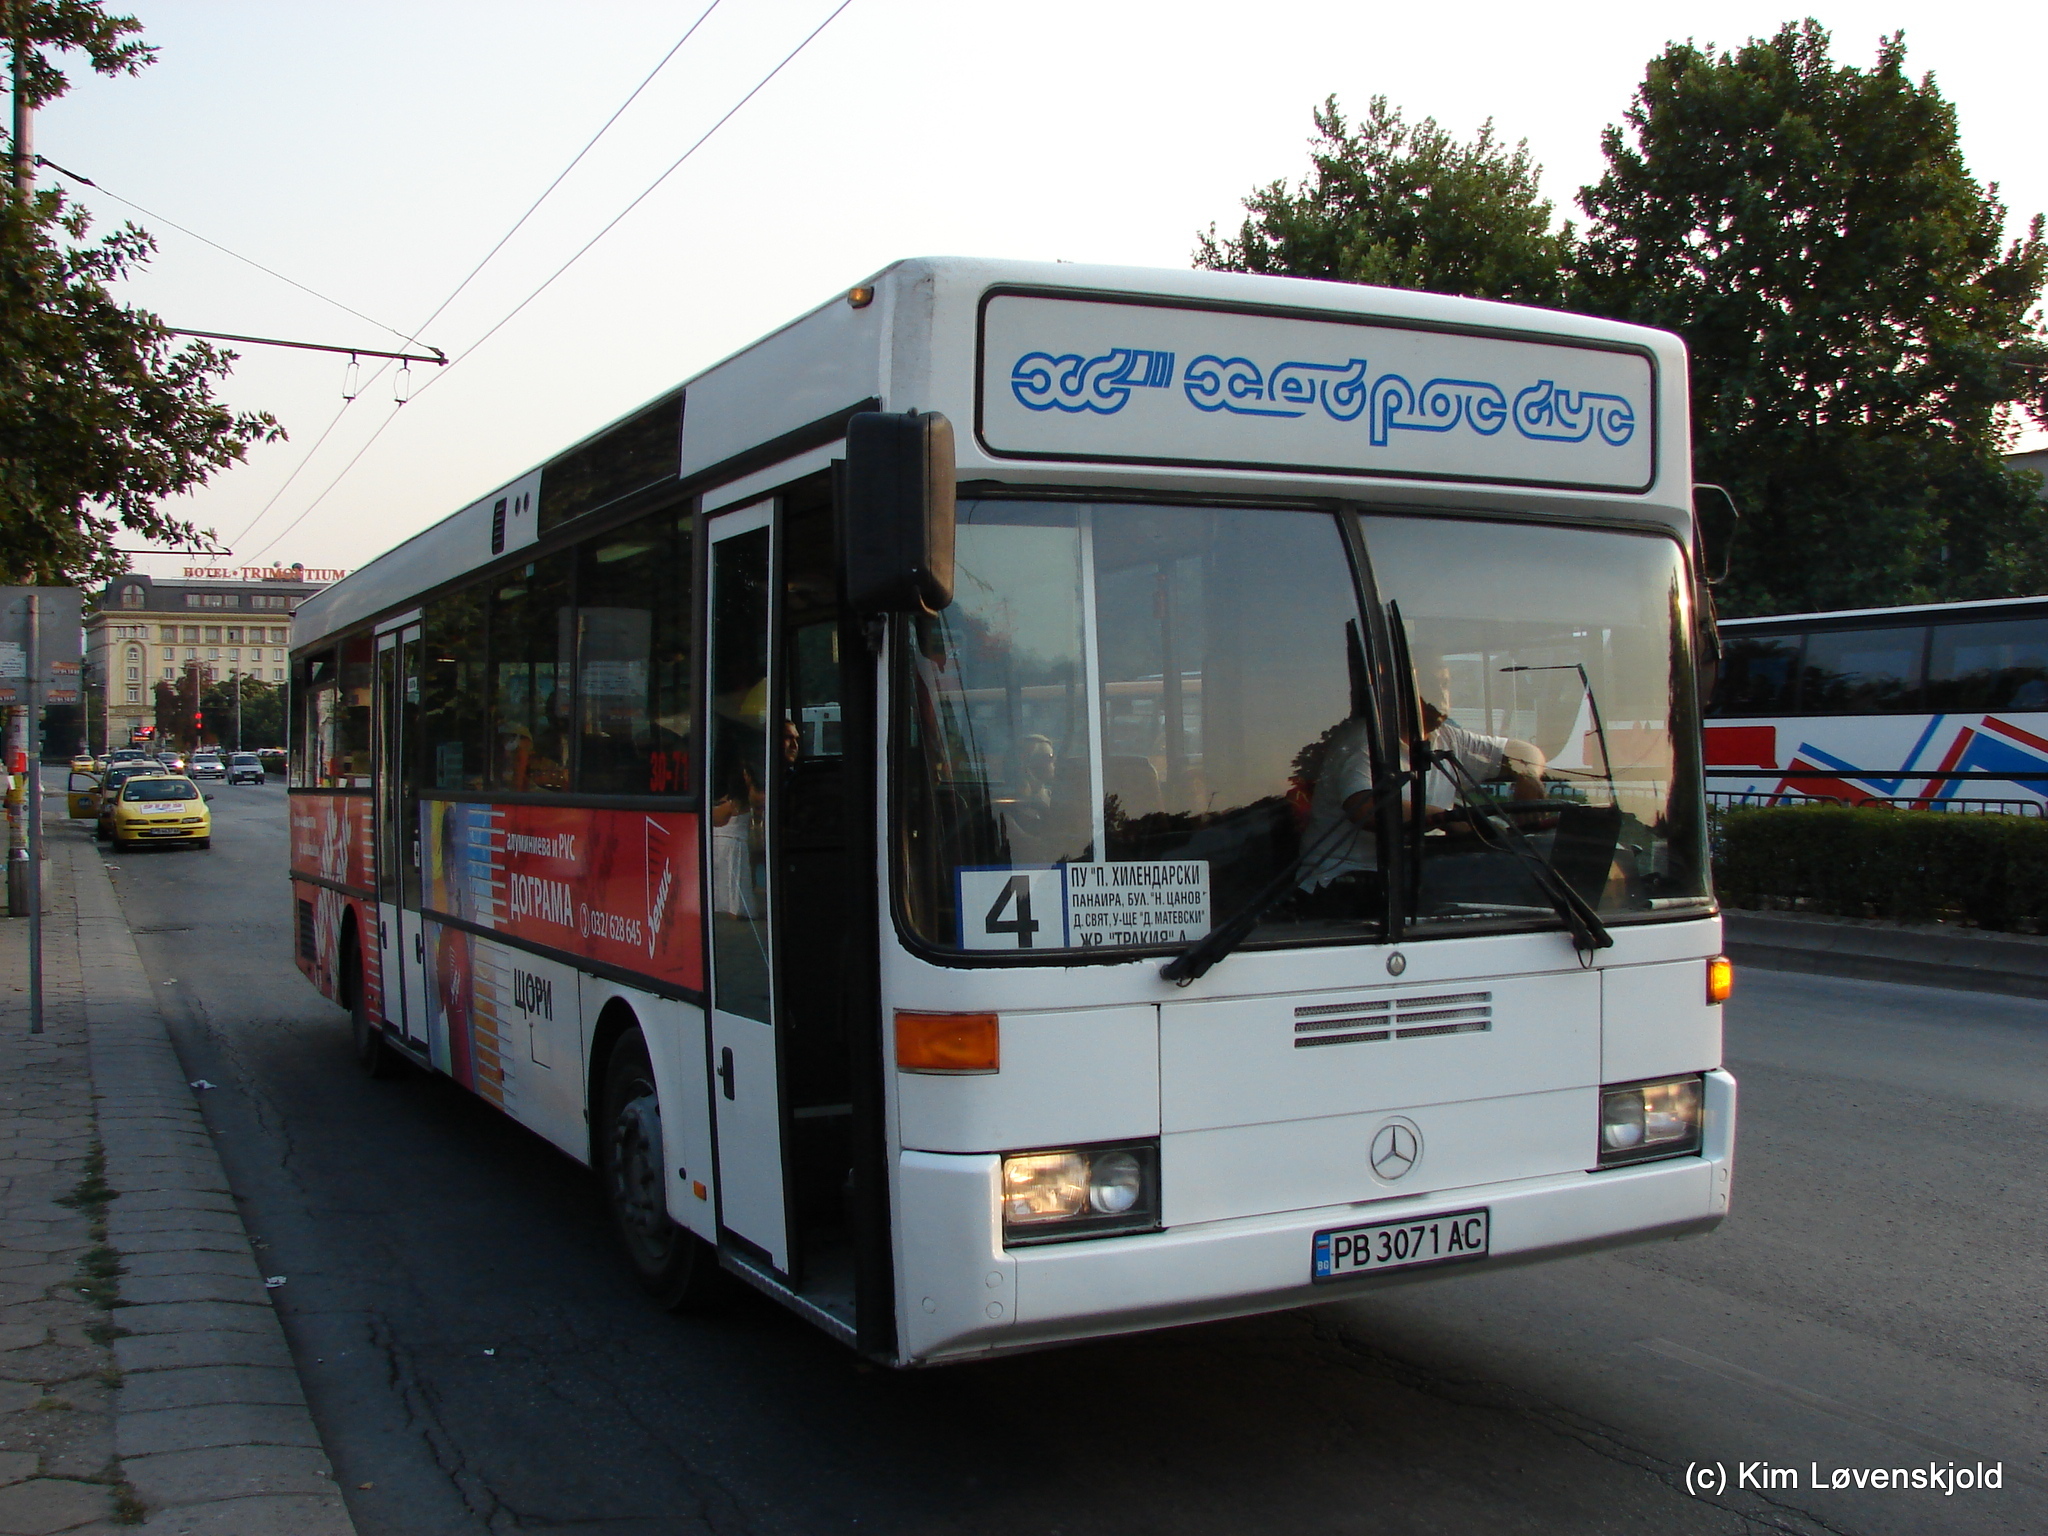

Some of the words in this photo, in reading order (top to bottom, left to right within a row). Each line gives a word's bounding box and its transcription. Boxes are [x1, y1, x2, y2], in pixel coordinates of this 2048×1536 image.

[183, 567, 231, 578] HOTEL
[240, 567, 347, 581] TRIMONTIUM
[559, 833, 576, 861] PVC
[1071, 867, 1087, 887] ПУ
[1112, 865, 1200, 889] ХИЛЕНДАРСКИ
[510, 872, 574, 928] ДОГРАМА
[985, 875, 1039, 948] 4
[1072, 893, 1124, 908] ПАНАИРА,
[1128, 892, 1149, 906] БУЛ.
[610, 915, 625, 942] 628
[626, 918, 642, 946] 645
[1112, 912, 1137, 927] У-ЩЕ
[514, 968, 553, 1021] ЩОРИ
[1335, 1234, 1370, 1269] PB
[1376, 1223, 1439, 1263] 3071
[1448, 1218, 1482, 1252] AC
[1317, 1260, 1329, 1271] BG
